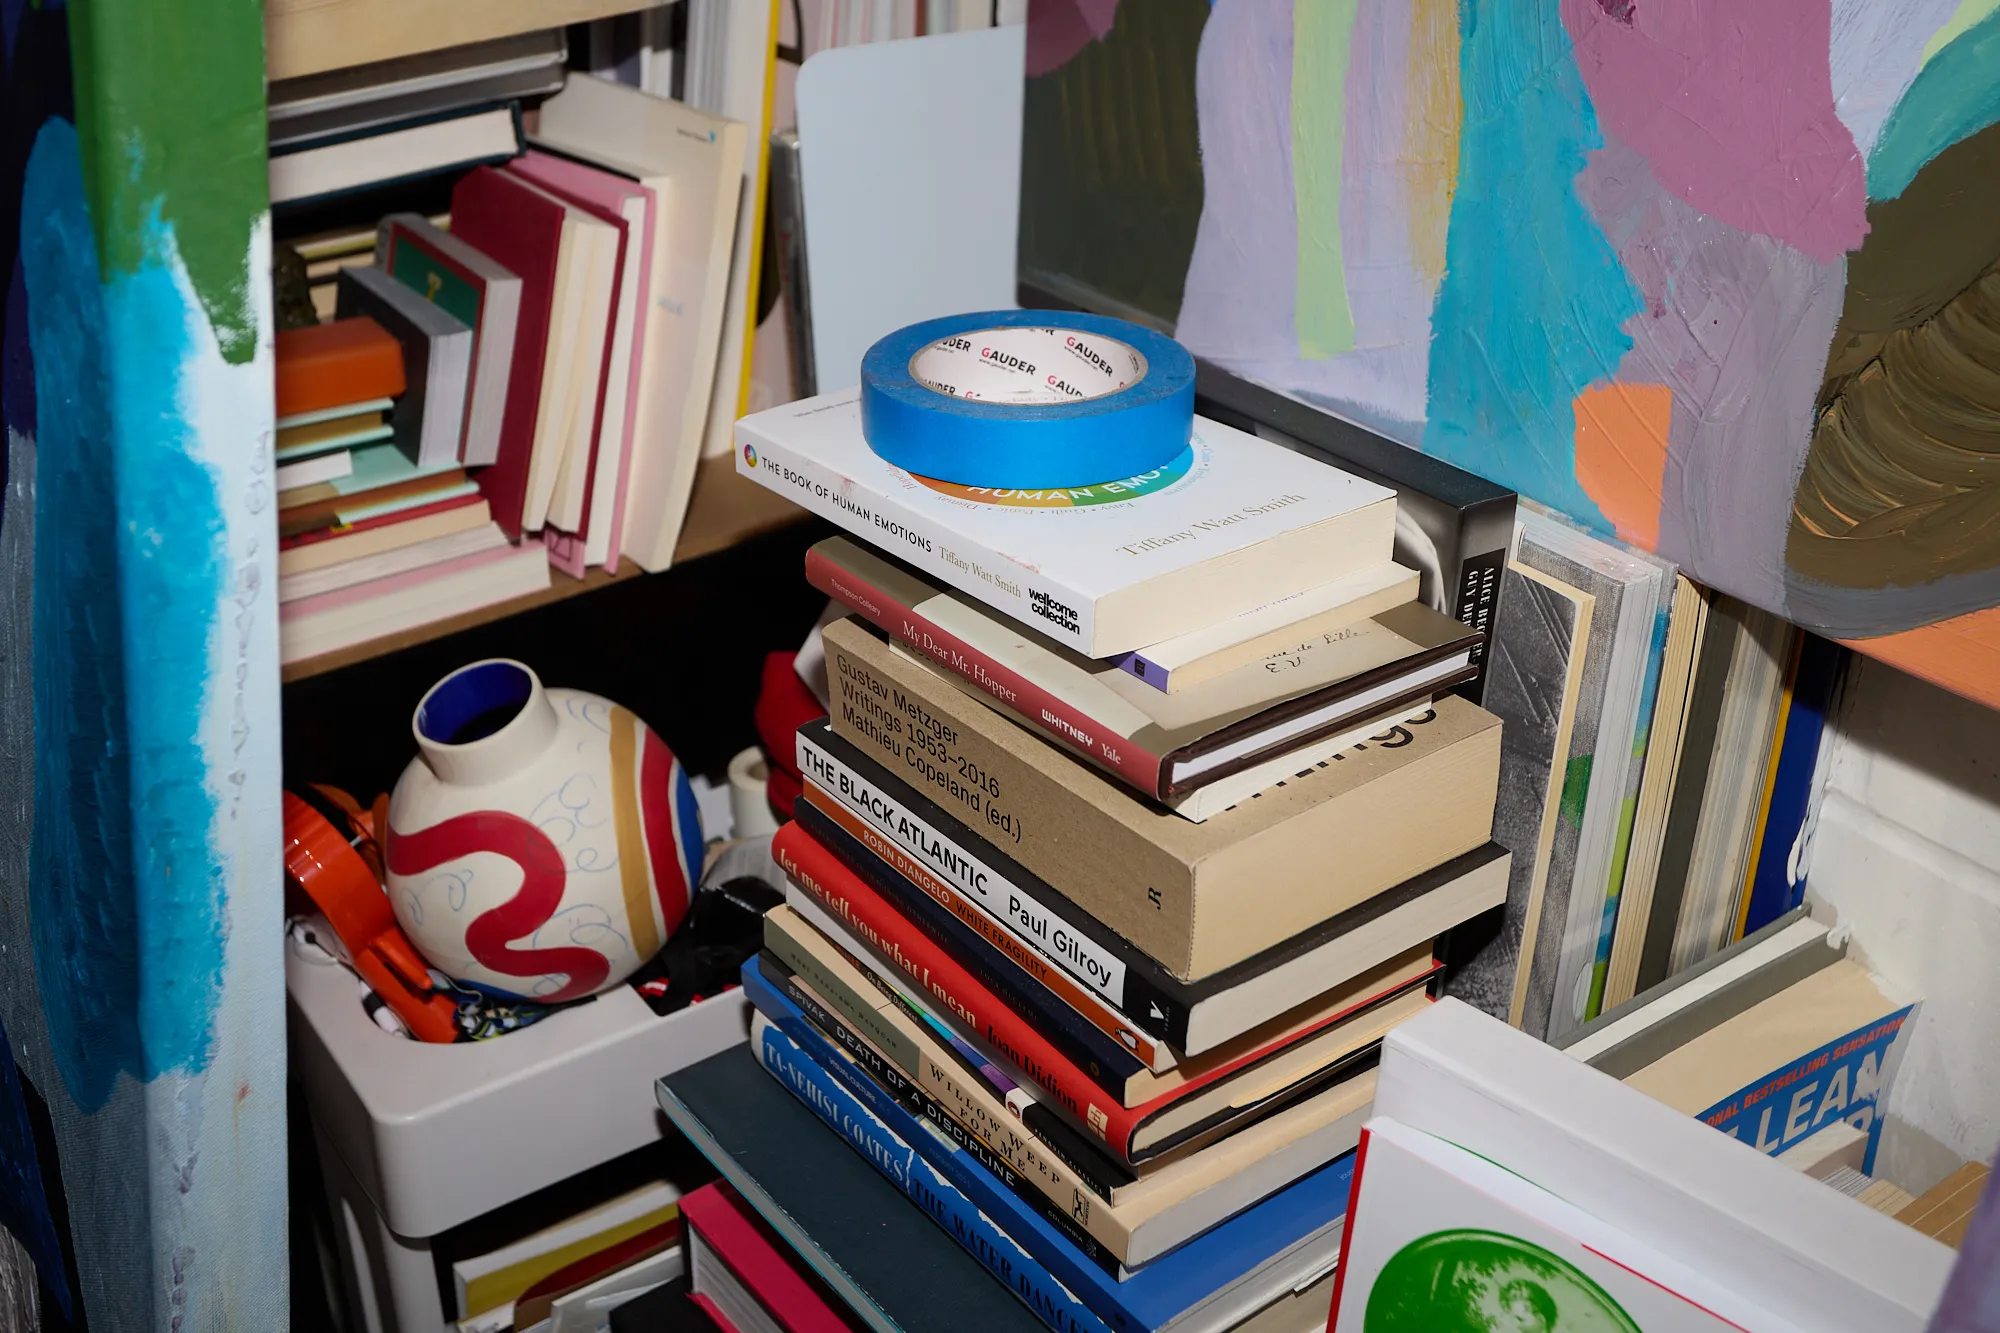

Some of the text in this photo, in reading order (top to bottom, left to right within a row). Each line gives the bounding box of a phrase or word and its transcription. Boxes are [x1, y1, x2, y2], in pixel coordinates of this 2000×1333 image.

[981, 347, 1036, 375] GAUDER
[1066, 336, 1113, 377] GAUDER
[761, 456, 932, 553] THE BOOK OF HUMAN EMOTIONS
[967, 486, 1095, 501] HUMAN
[1116, 493, 1308, 558] Tiffany Watt Smith
[939, 545, 1021, 598] Tiffany Watt Smith
[1028, 587, 1078, 620] wellcome
[1465, 570, 1479, 597] GUY
[1480, 567, 1495, 605] ALICE
[1031, 602, 1080, 635] collection
[903, 620, 921, 647] My
[923, 633, 948, 660] Dear
[951, 650, 971, 675] Mr.
[974, 664, 1017, 703] Hopper
[836, 654, 889, 700] Gustav
[893, 689, 958, 745] Metzger
[839, 677, 902, 733] Writings
[1041, 708, 1093, 747] WHITNEY
[842, 702, 1021, 843] Mathieu Copeland (ed.)
[1101, 743, 1121, 765] Yale
[802, 746, 988, 896] THE BLACK ATLANTIC
[863, 829, 1048, 980] ROBIN DIANGELO WHITE FRAGILITY
[1009, 894, 1112, 987] Paul Gilroy
[780, 848, 1078, 1113] let me tell you what I mean Joan Didion
[788, 985, 826, 1023] SPIVAK
[836, 1025, 881, 1071] DEATH
[886, 1069, 907, 1090] OF
[911, 1092, 921, 1106] A
[926, 1105, 1015, 1187] DISCIPLINE
[1743, 1052, 1830, 1110] BESTSELLING
[1831, 1015, 1905, 1061] SENSATION
[766, 1041, 903, 1182] TA-NEHISI COATES
[929, 1063, 1061, 1184] WILLOW WEEP
[959, 1106, 1026, 1172] FOR ME
[913, 1178, 947, 1223] THE
[953, 1215, 1012, 1277] WATER
[1047, 1209, 1083, 1243] COLUMBIA
